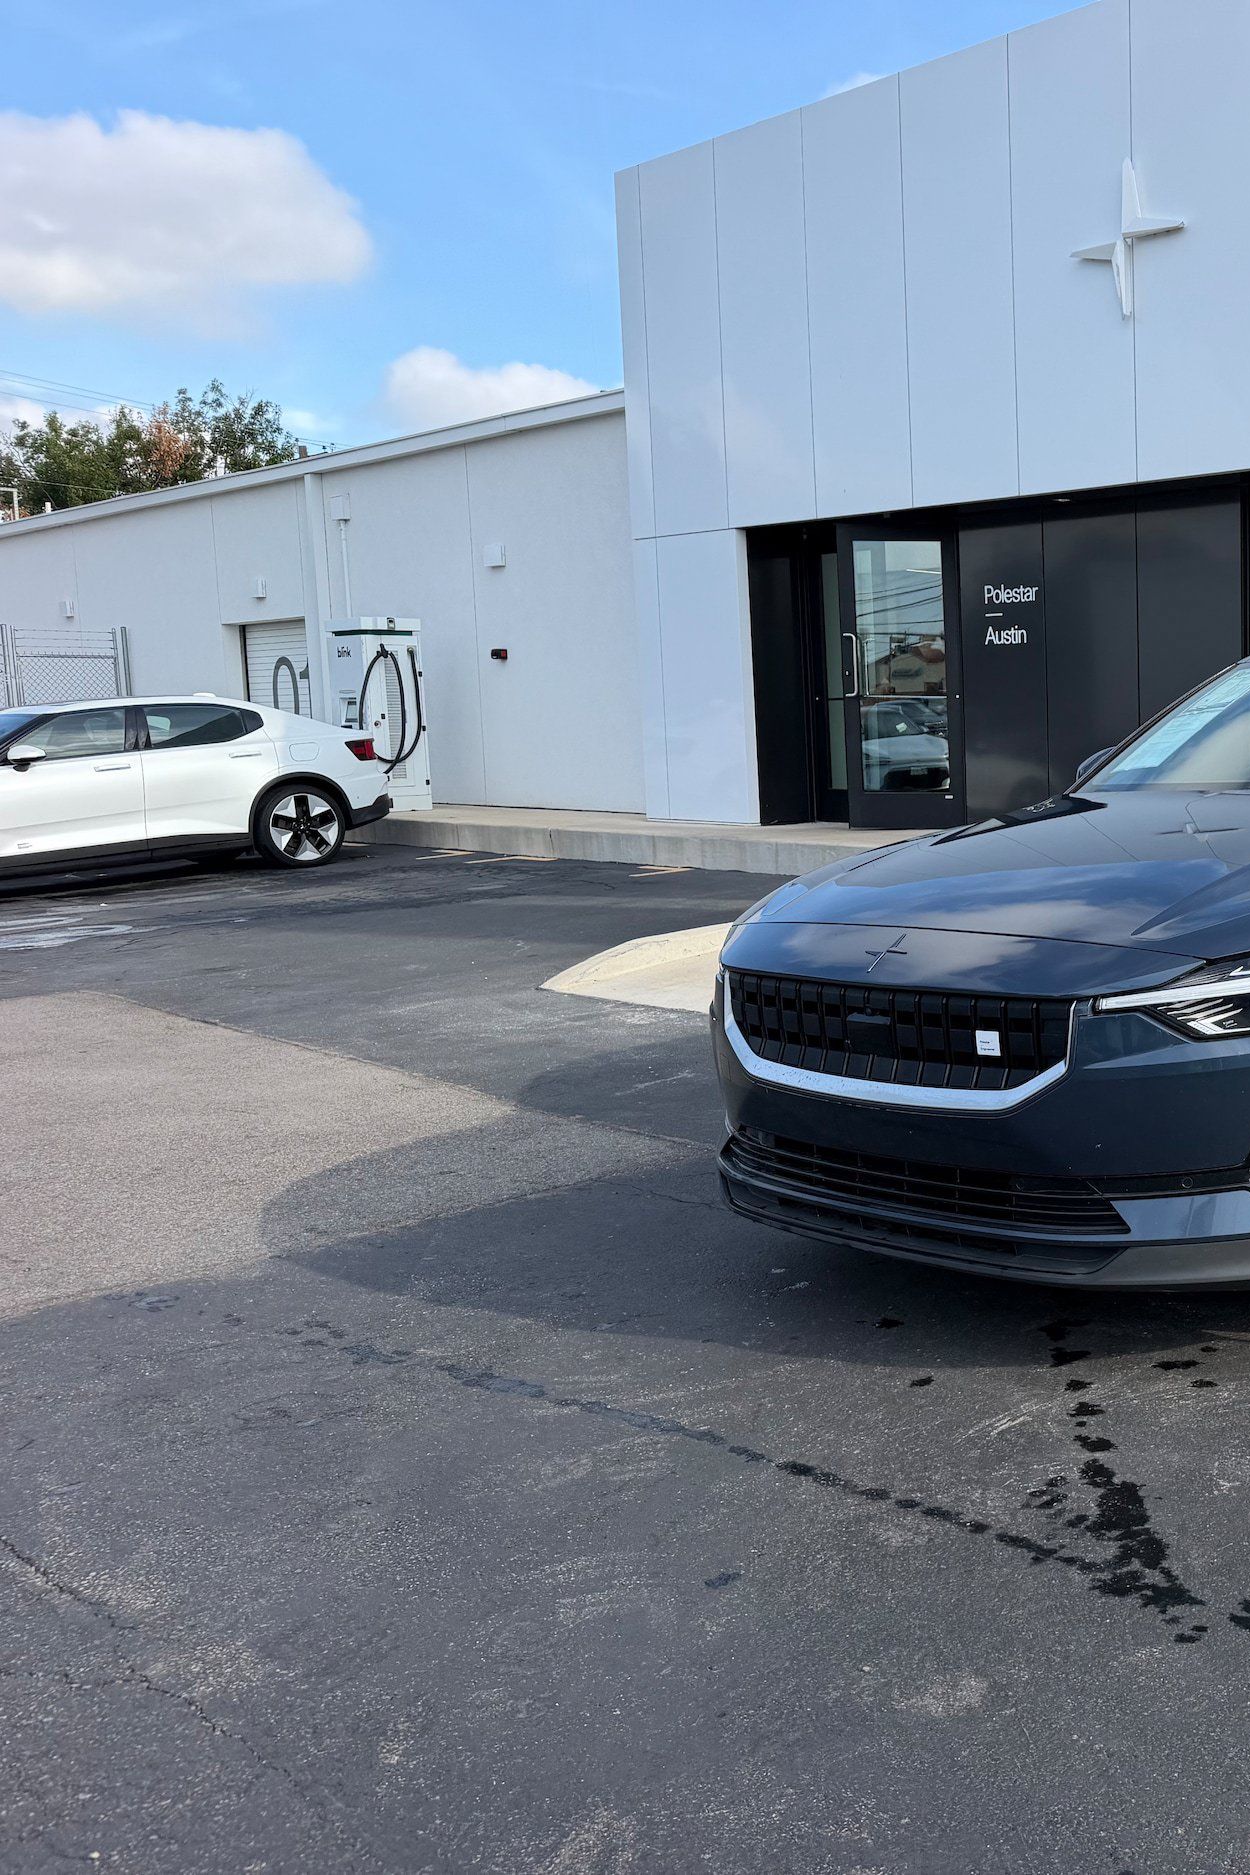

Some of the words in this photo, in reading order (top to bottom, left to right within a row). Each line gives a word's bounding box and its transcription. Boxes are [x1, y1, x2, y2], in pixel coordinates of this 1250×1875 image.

[984, 584, 1039, 604] Polestar
[984, 625, 1028, 645] Austin
[337, 646, 352, 658] blink
